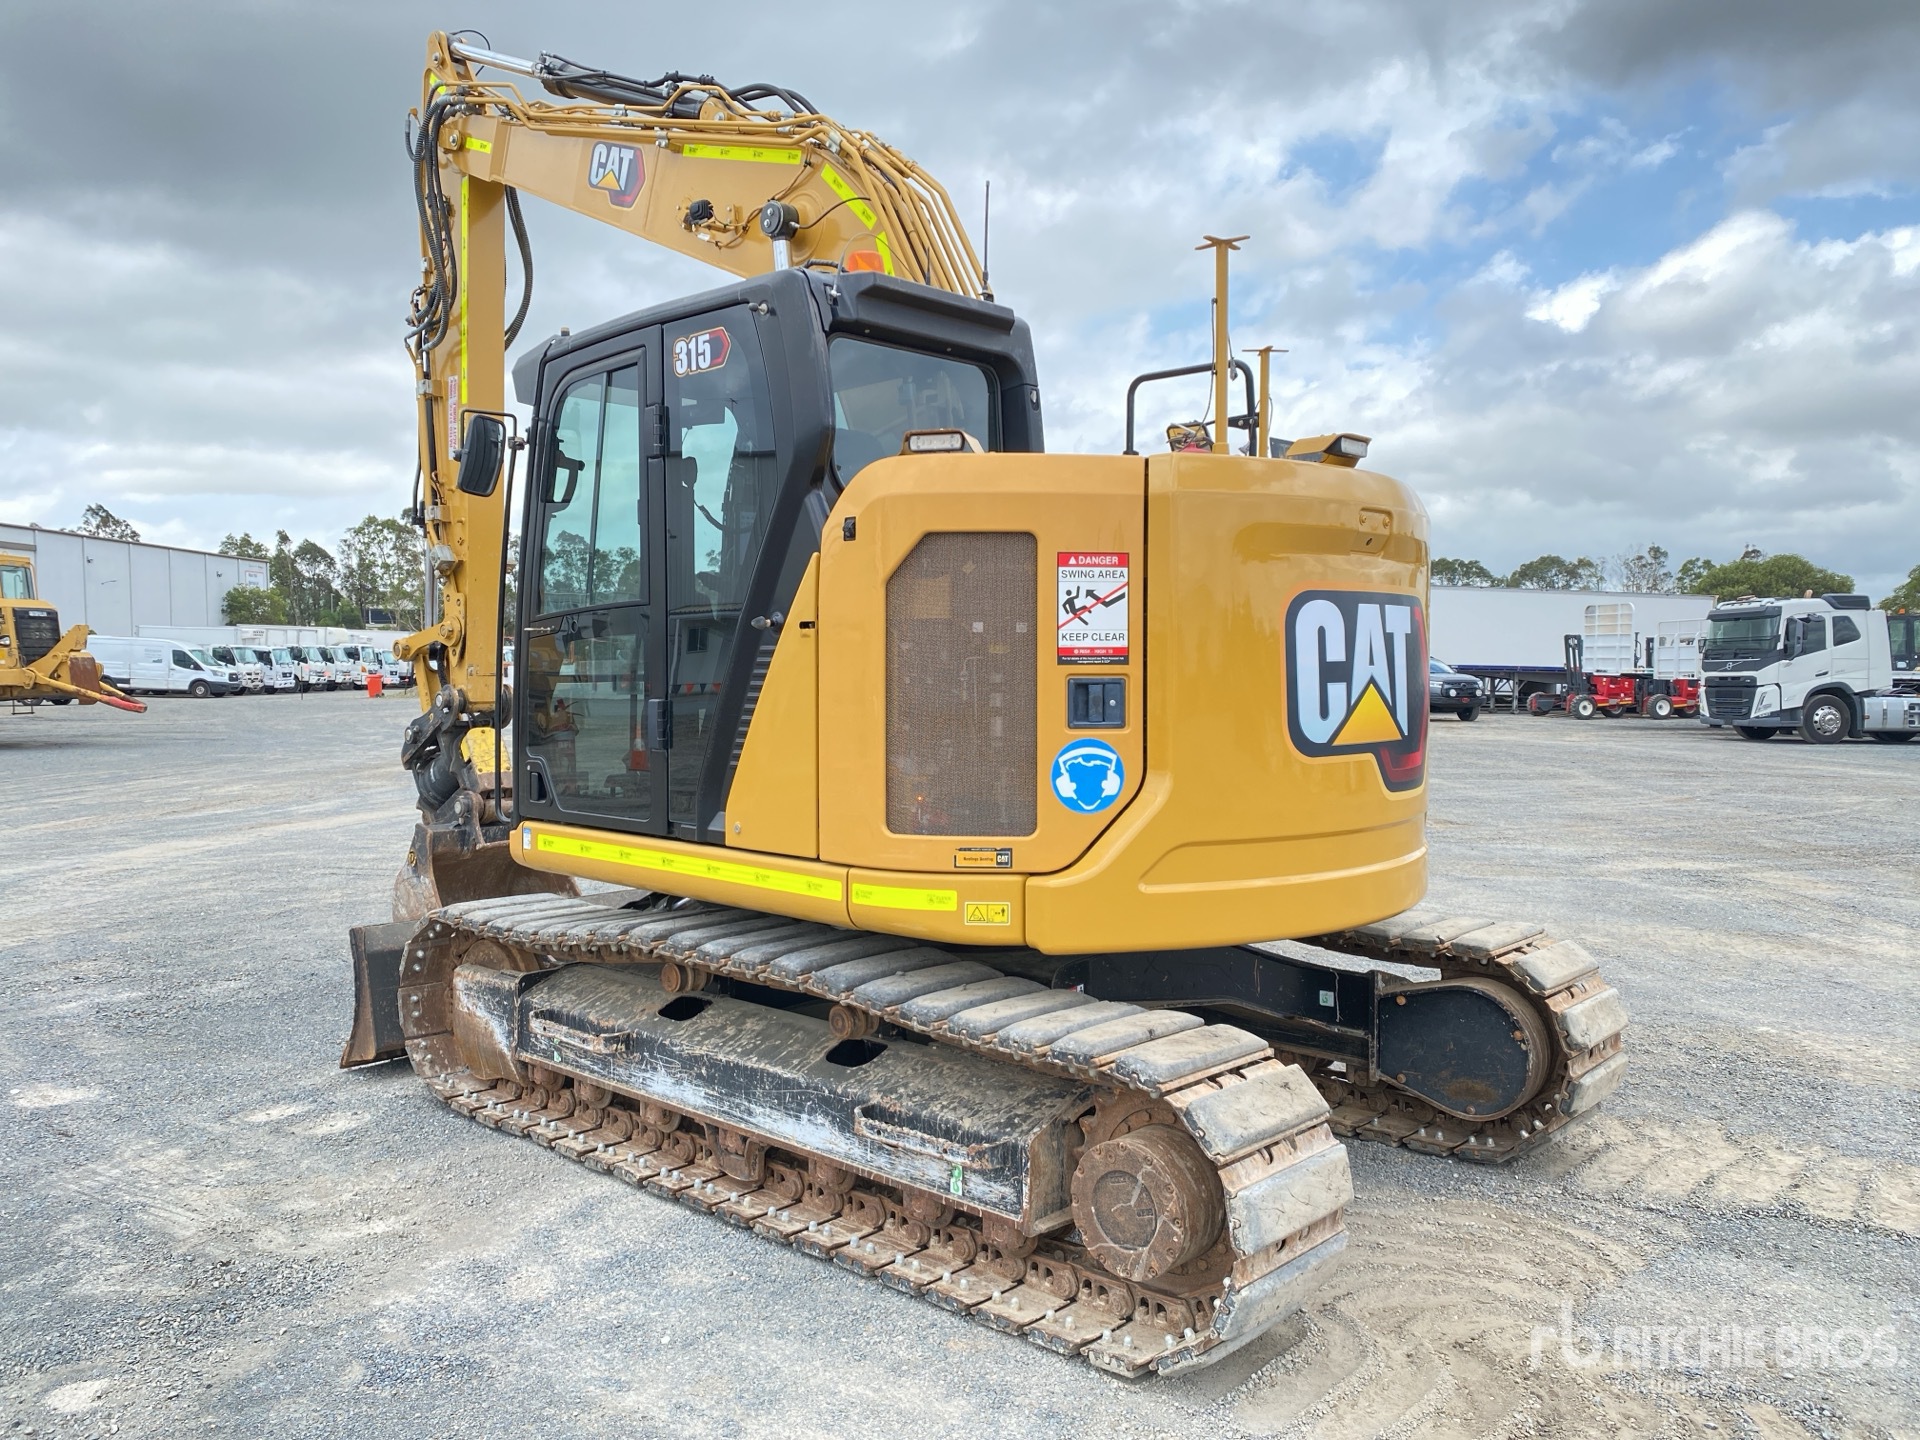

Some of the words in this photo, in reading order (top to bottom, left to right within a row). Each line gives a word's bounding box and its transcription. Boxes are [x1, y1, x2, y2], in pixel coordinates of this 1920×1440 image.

[590, 144, 635, 191] CAT
[675, 333, 711, 374] 315
[1078, 556, 1119, 565] DANGER
[1061, 569, 1095, 579] SWING
[1097, 569, 1126, 579] AREA
[1061, 632, 1089, 642] KEEP
[1091, 632, 1125, 642] CLEAR
[1295, 599, 1412, 744] CAT
[997, 854, 1009, 863] CAT
